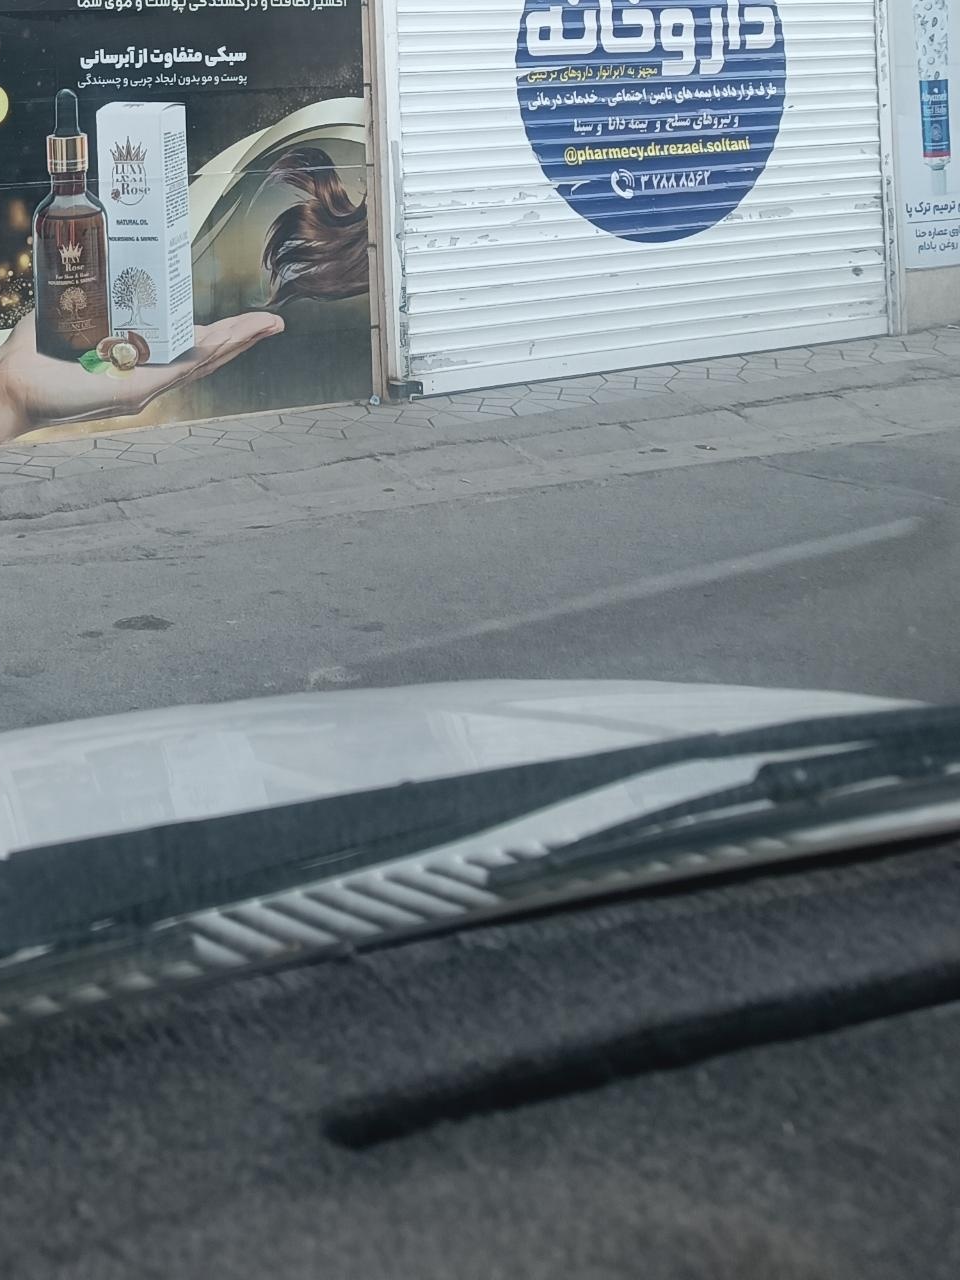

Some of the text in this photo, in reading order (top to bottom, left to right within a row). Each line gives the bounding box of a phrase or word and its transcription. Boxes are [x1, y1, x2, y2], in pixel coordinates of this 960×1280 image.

[104, 0, 132, 11] موی
[135, 0, 143, 11] و
[260, 0, 268, 11] و
[80, 46, 247, 69] سبکی متفاوت از آبرسانی
[626, 66, 636, 78] به
[637, 64, 658, 79] مجهز
[77, 73, 248, 90] پوست و مو بدون ایجاد چربی و چسبندگی
[564, 89, 598, 104] خدمات
[608, 88, 647, 107] اجتماعی
[649, 86, 672, 105] تامین
[675, 86, 693, 104] های
[694, 90, 712, 101] بیمه
[713, 85, 721, 101] با
[756, 82, 778, 100] طرف
[528, 91, 563, 111] درمانی
[573, 119, 593, 136] سینا
[596, 122, 603, 136] و
[608, 116, 626, 131] دانا
[628, 119, 649, 133] بیمه
[654, 120, 661, 132] و
[665, 114, 691, 131] مسلح
[564, 136, 750, 165] @pharmecy.dr.rezaei.soltani
[121, 182, 150, 195] Rose
[906, 203, 913, 218] پا
[915, 201, 931, 215] ترک
